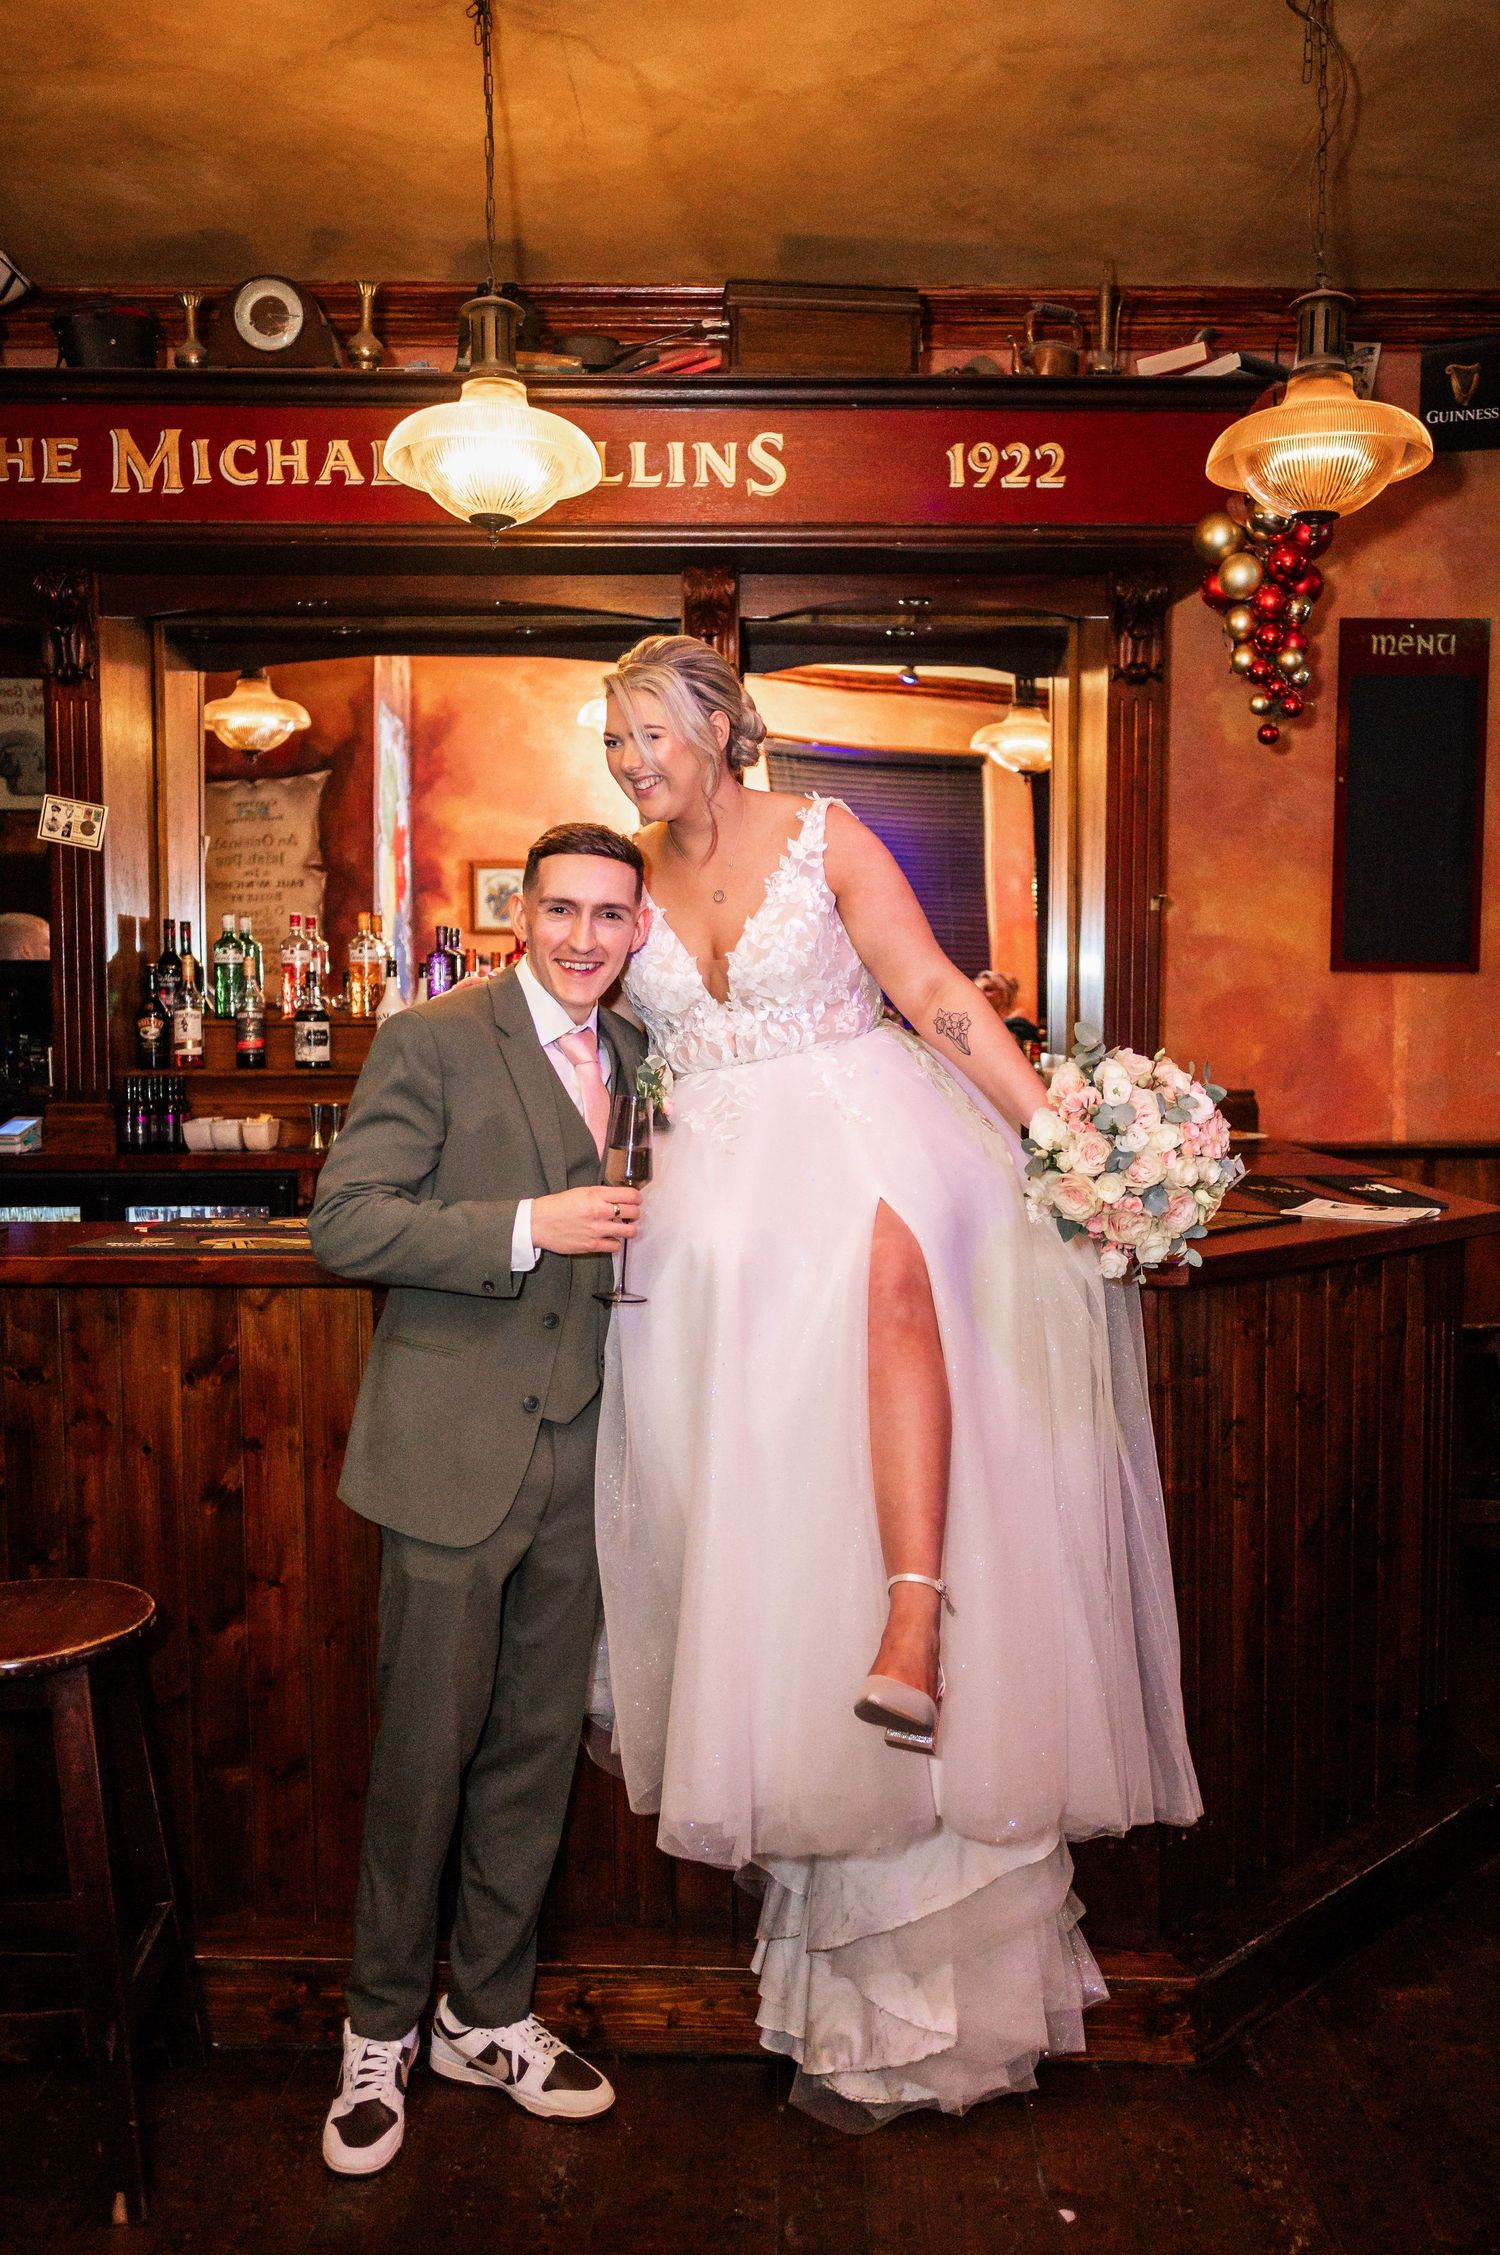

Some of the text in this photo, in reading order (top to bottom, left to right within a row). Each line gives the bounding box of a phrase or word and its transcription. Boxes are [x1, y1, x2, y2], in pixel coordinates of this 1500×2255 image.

[1426, 407, 1500, 424] GUINNESS
[594, 431, 787, 497] LLINS
[945, 441, 1067, 489] 1922
